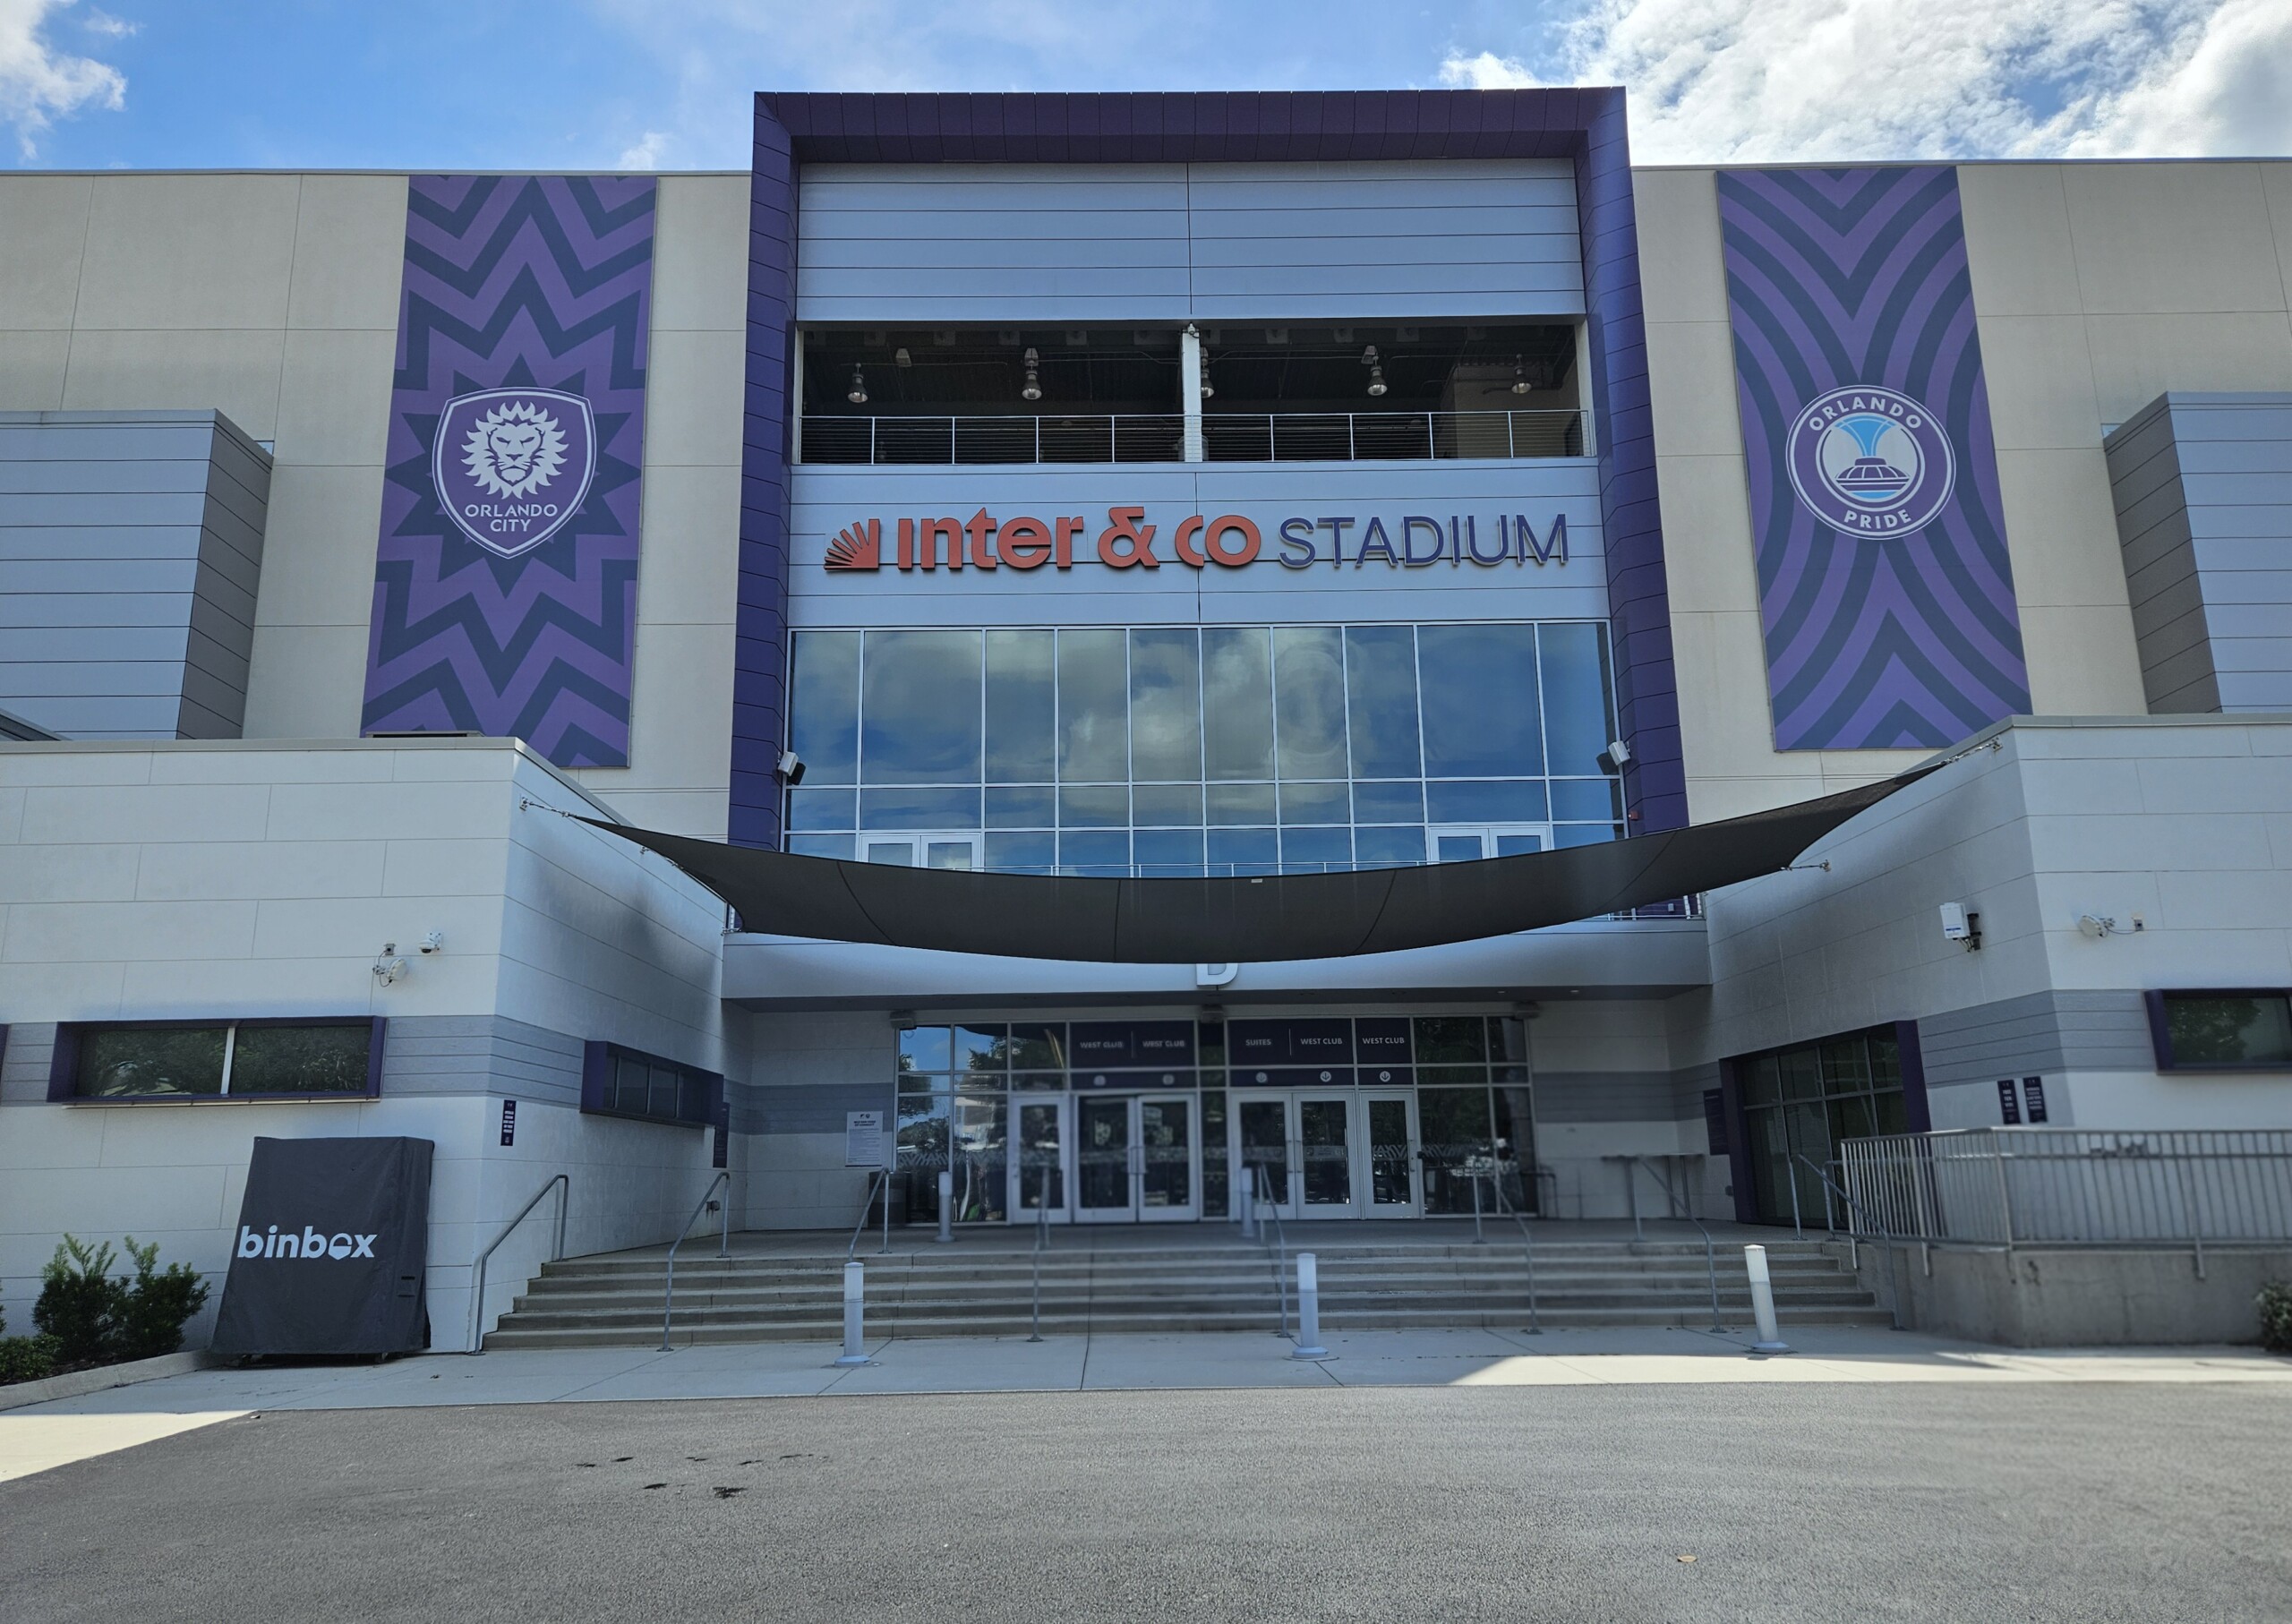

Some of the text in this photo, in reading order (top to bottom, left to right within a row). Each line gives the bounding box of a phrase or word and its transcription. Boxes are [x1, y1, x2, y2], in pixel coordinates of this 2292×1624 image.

[1809, 397, 1922, 432] ORLANDO
[464, 503, 559, 517] ORLANDO
[489, 518, 532, 533] CITY
[1843, 509, 1912, 529] PRIDE
[1098, 506, 1160, 568] &
[1175, 514, 1262, 568] co
[1278, 513, 1569, 568] STADIUM
[1080, 1041, 1125, 1049] WEST CLUB
[1142, 1039, 1185, 1048] WEST CLUB
[1245, 1039, 1272, 1047] SUITES
[1300, 1038, 1343, 1046] WEST CLUB
[1362, 1037, 1405, 1045] WEST CLUB
[236, 1224, 378, 1261] binbox
